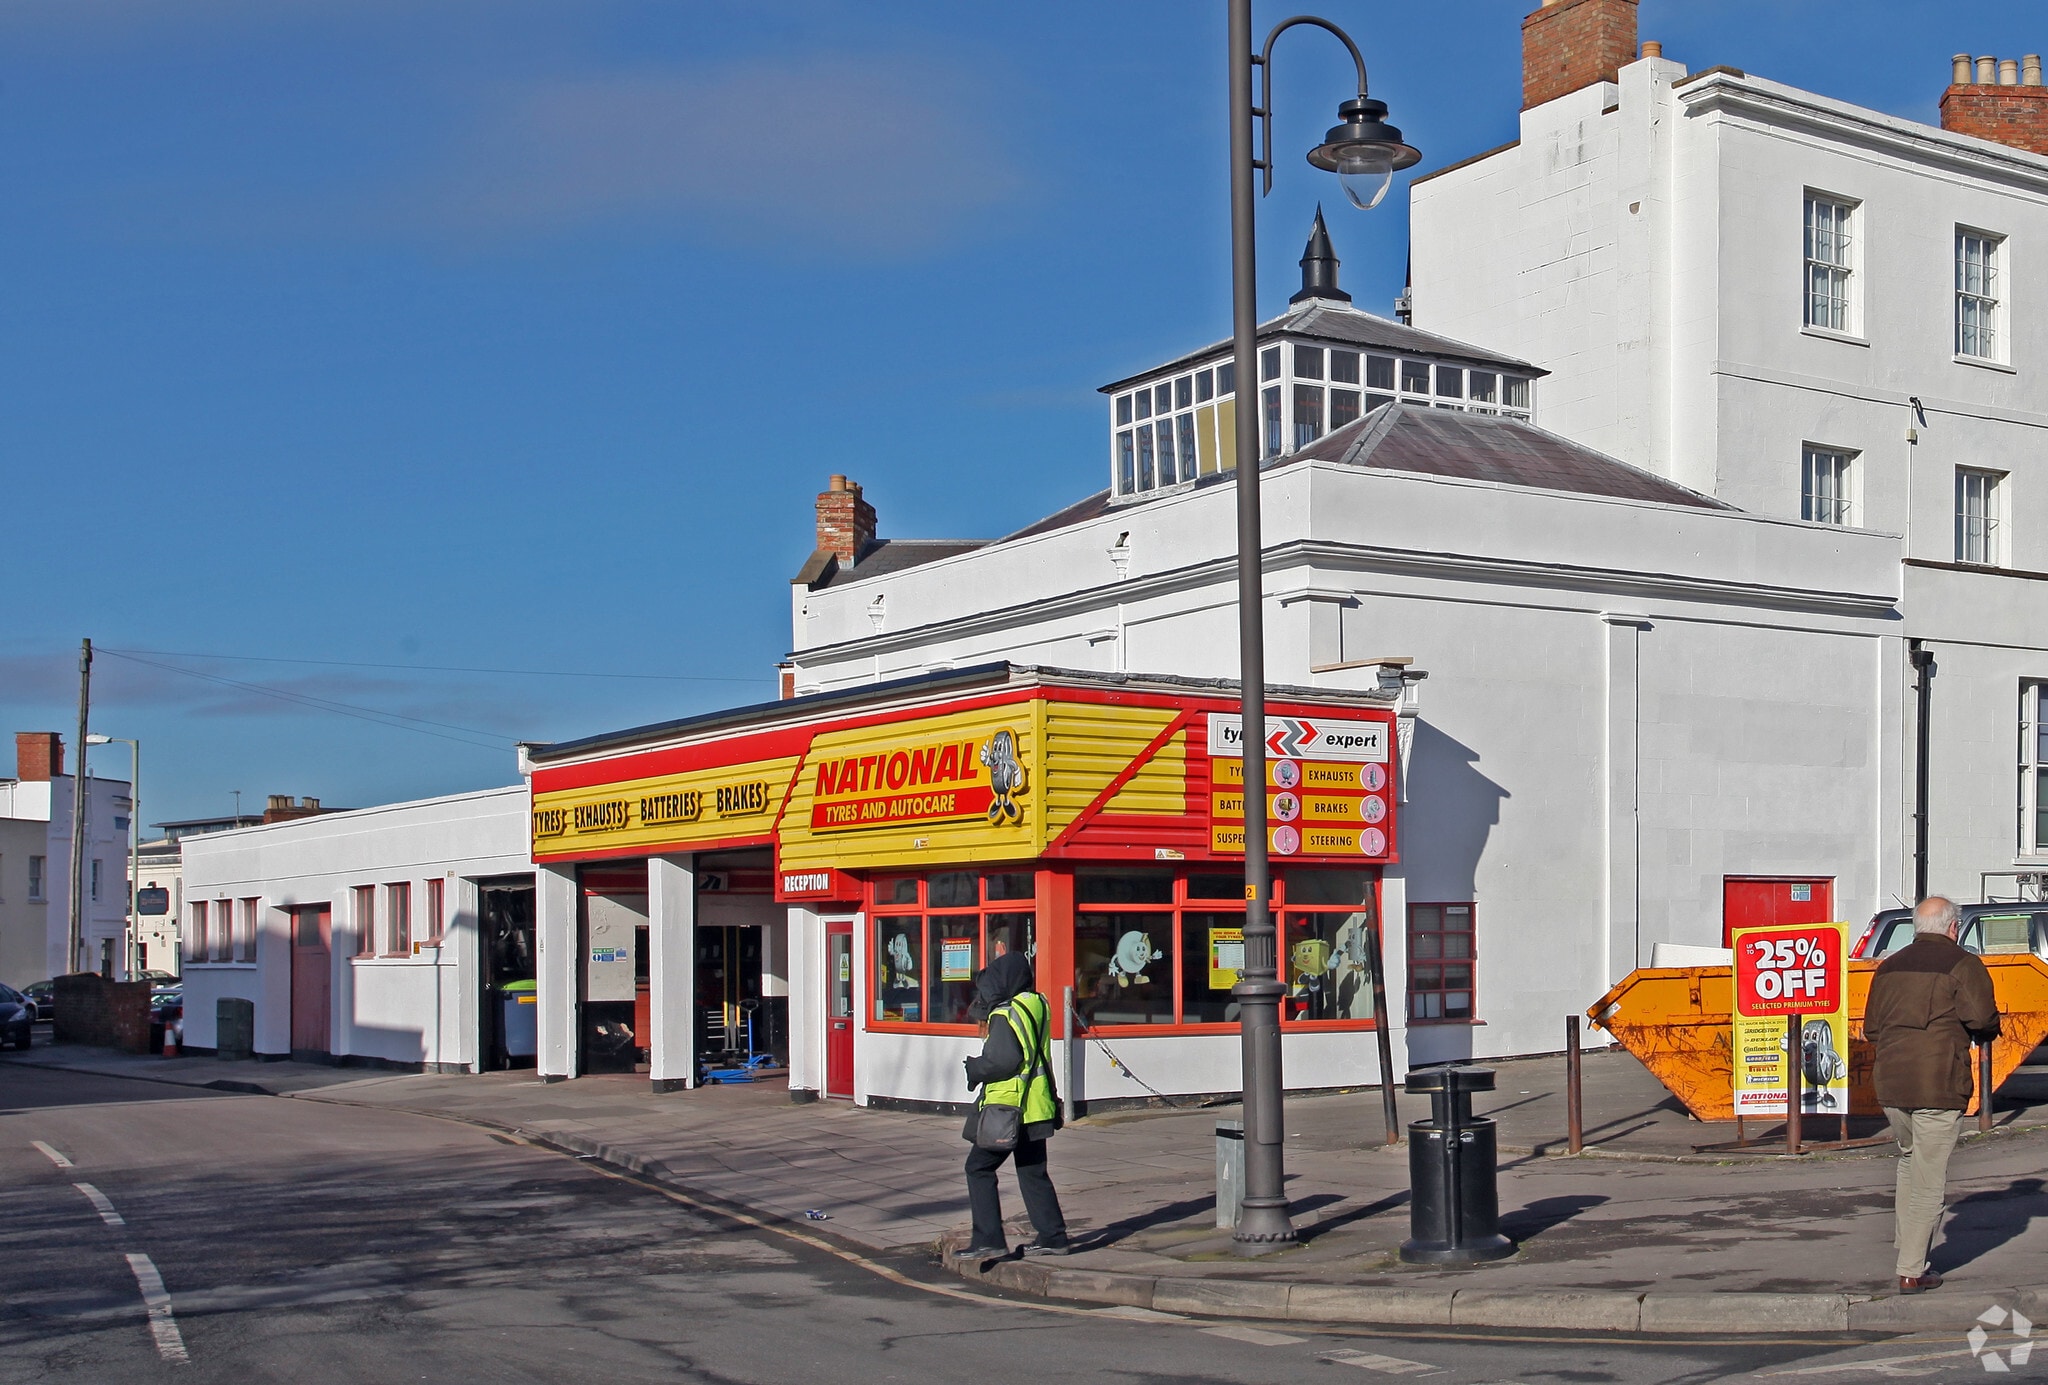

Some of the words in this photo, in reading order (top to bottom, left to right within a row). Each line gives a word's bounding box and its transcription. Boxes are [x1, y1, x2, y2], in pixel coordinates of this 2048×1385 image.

[1224, 727, 1243, 743] ty
[1326, 734, 1377, 749] expert
[815, 742, 978, 797] NATIONAL
[1309, 770, 1354, 782] EXHAUSTS
[641, 792, 696, 821] BATTERIES
[717, 782, 762, 813] BRAKES
[574, 801, 623, 829] EXHAUSTS
[826, 804, 858, 823] TYRES
[861, 802, 886, 820] AND
[889, 794, 955, 817] AUTOCARE
[1315, 803, 1348, 814] BRAKES
[534, 809, 561, 833] TYRES
[1310, 835, 1353, 846] STEERING
[784, 873, 829, 892] RECEPTION
[1246, 887, 1253, 898] 2
[1754, 936, 1826, 969] 25%
[1755, 968, 1825, 999] OFF
[1752, 1002, 1782, 1010] SELECTED
[1783, 1001, 1813, 1009] PREMIUM
